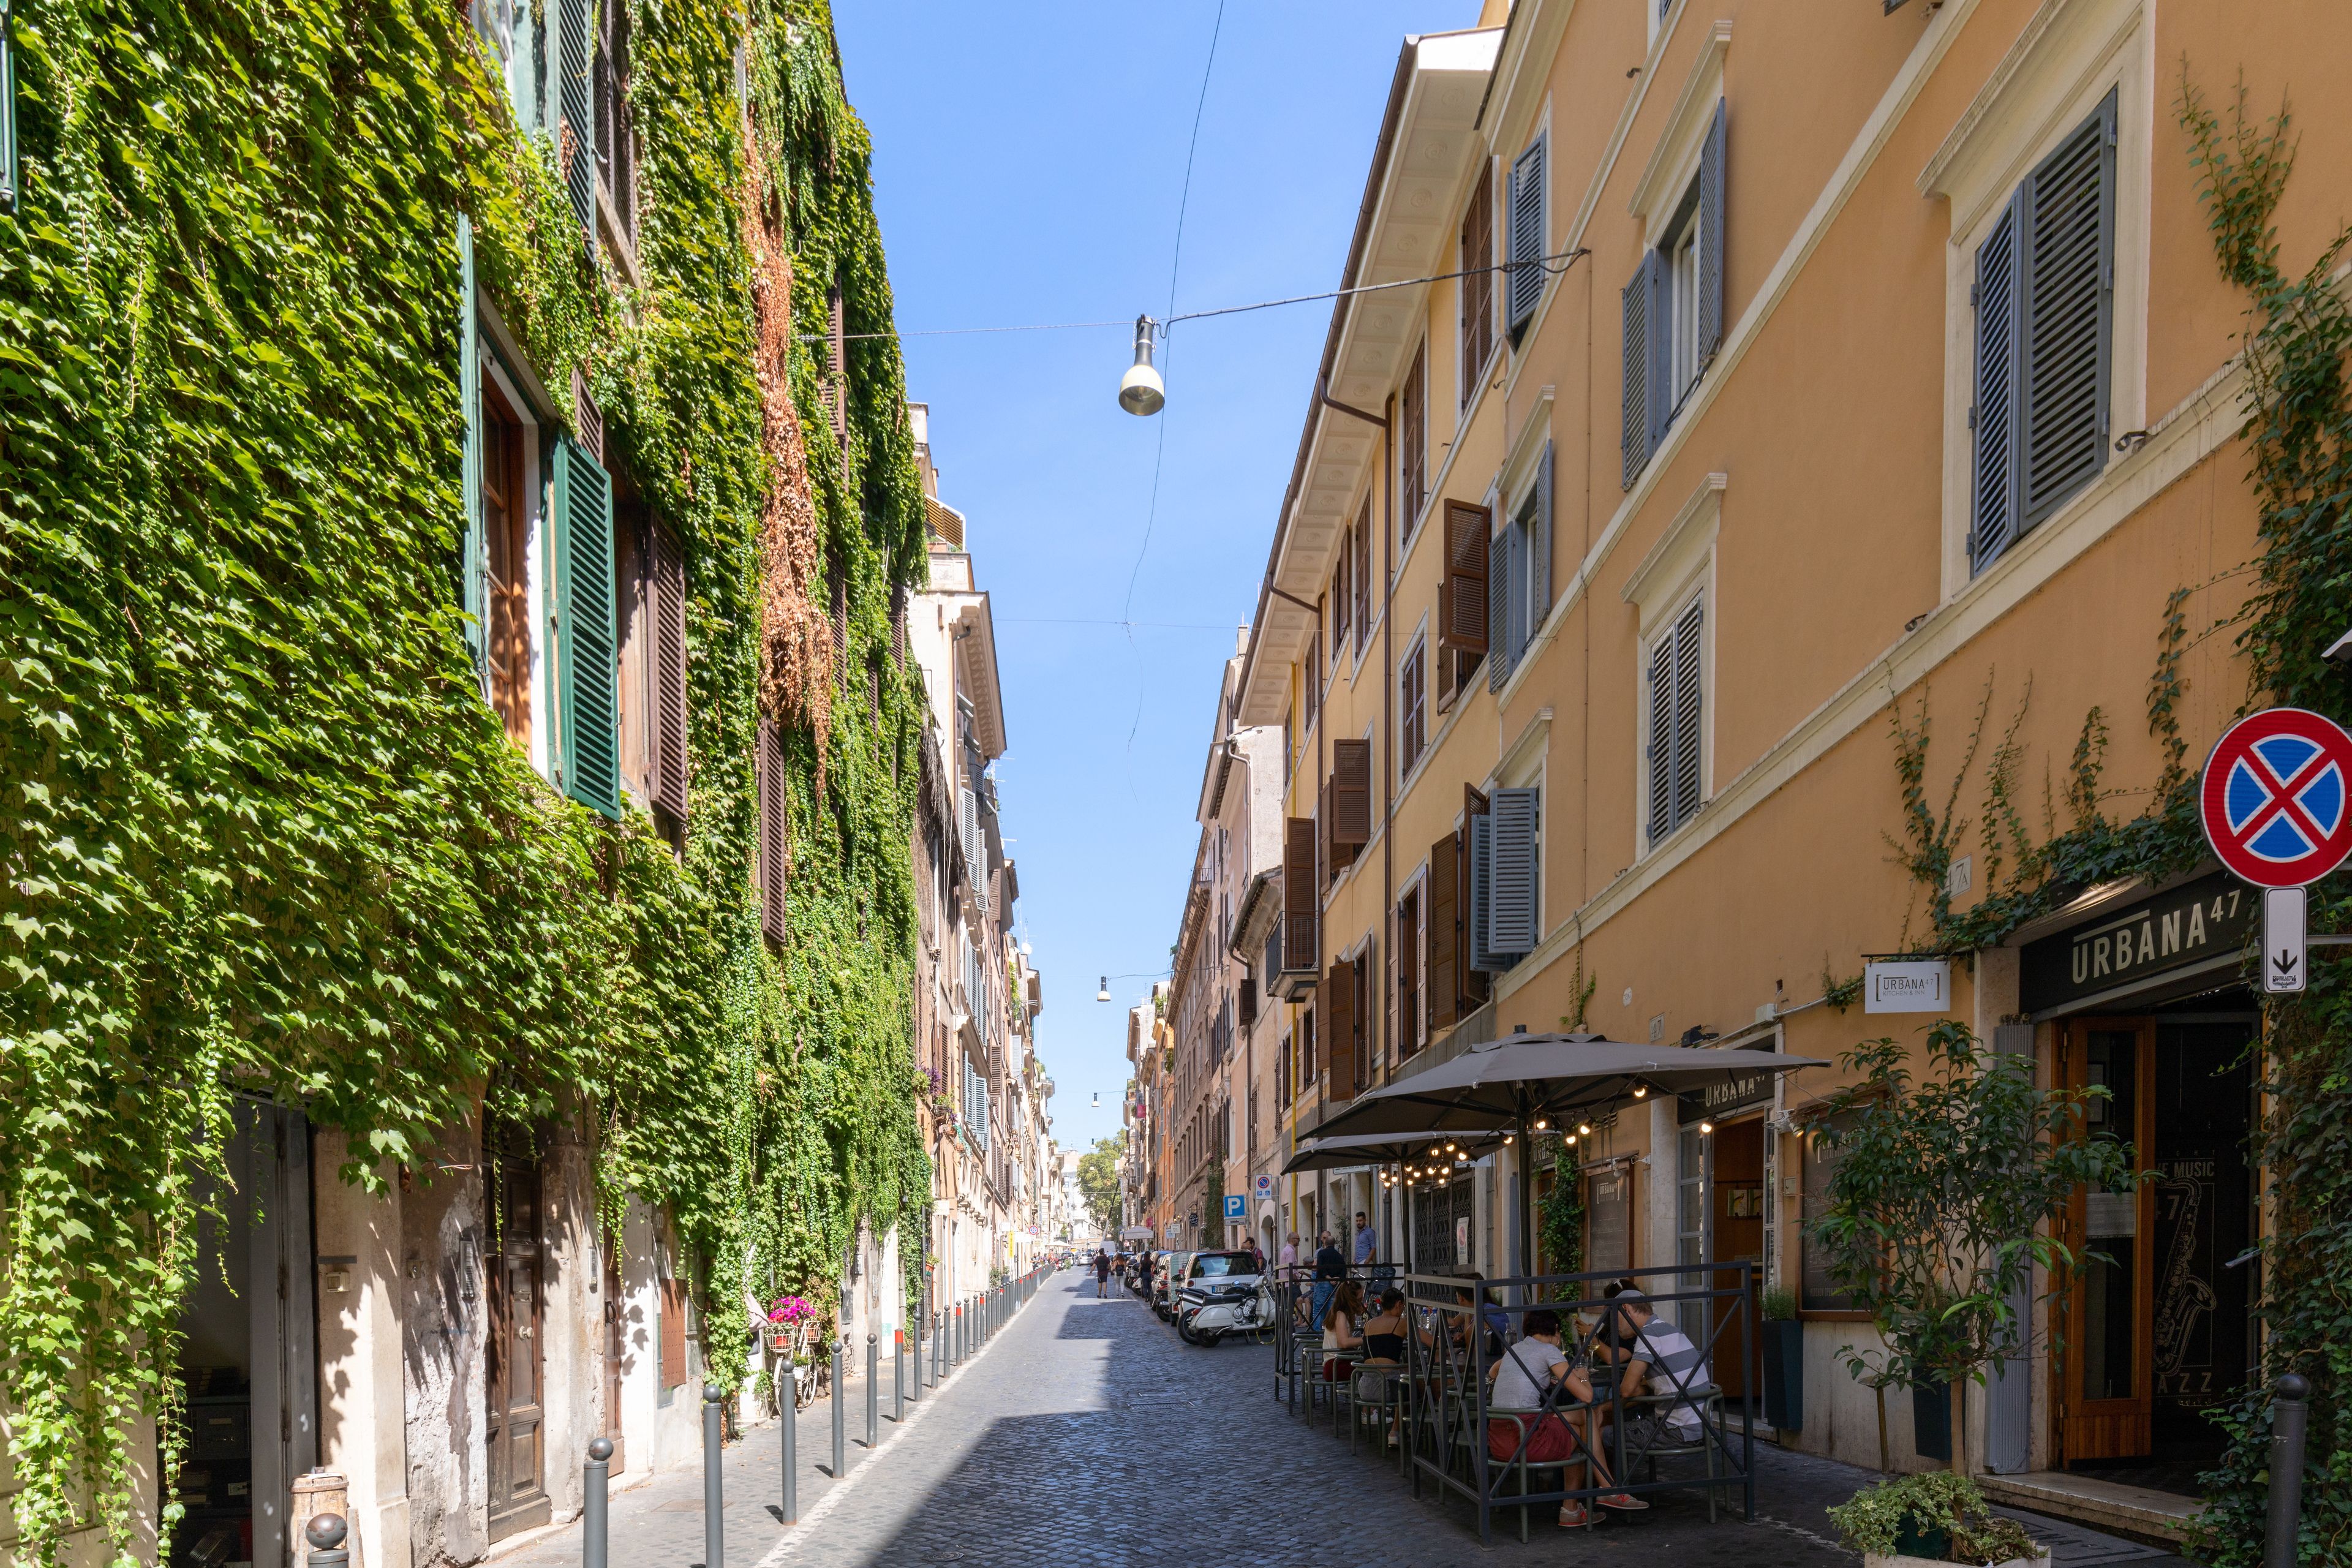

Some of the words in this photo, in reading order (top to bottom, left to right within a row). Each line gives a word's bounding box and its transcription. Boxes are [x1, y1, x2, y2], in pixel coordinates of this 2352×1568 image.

[2072, 902, 2206, 984] URBANA
[2211, 889, 2241, 922] 47
[1883, 978, 1925, 990] URBANA
[2174, 1161, 2215, 1177] MUSIC
[1599, 1183, 1615, 1195] URBANA
[1227, 1197, 1241, 1215] P
[2157, 1372, 2212, 1394] AZZ
